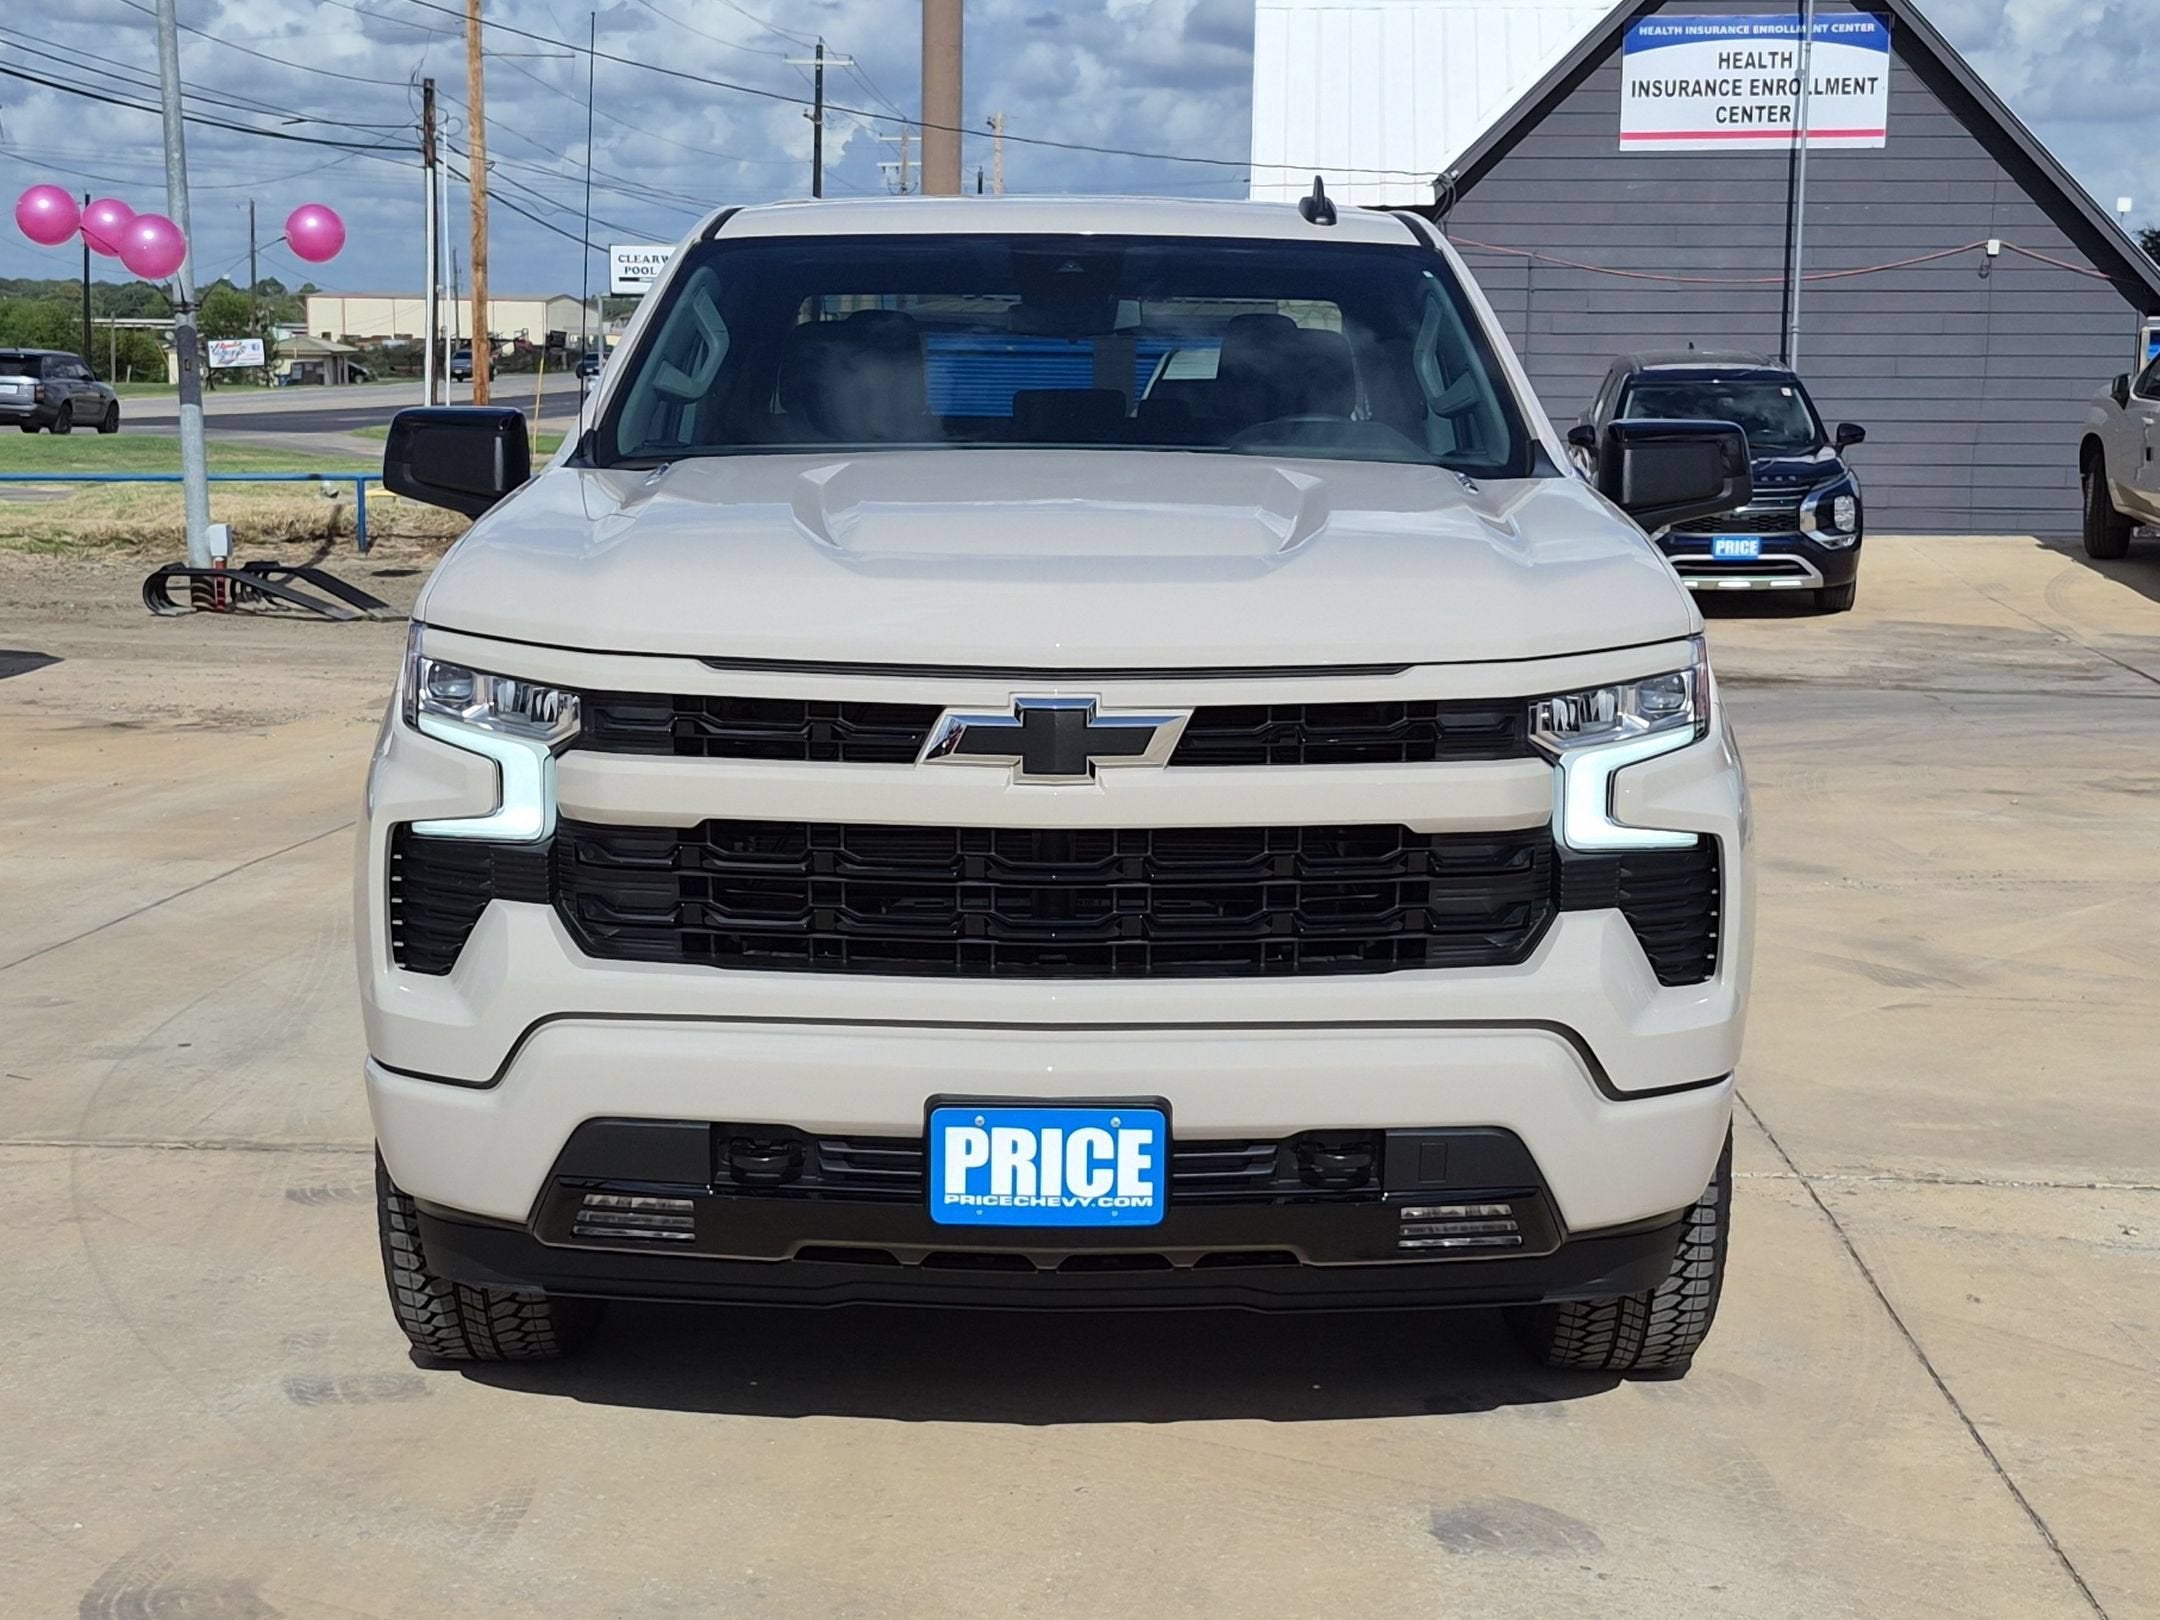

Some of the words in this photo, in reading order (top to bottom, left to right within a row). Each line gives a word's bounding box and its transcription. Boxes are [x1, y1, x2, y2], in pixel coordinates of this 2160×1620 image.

[1638, 25, 1682, 36] HEALTH
[1684, 24, 1750, 35] INSURANCE
[1752, 23, 1829, 34] ENROLLMNT
[1831, 22, 1875, 33] CENTER
[1718, 51, 1793, 70] HEALTH
[1631, 78, 1742, 98] INSURANCE
[1749, 77, 1879, 96] ENROLMENT
[1715, 105, 1791, 123] CENTER
[1714, 539, 1759, 556] PRICE
[945, 1126, 1154, 1197] PRICE
[944, 1194, 1154, 1208] PRICECHEVY.COM
